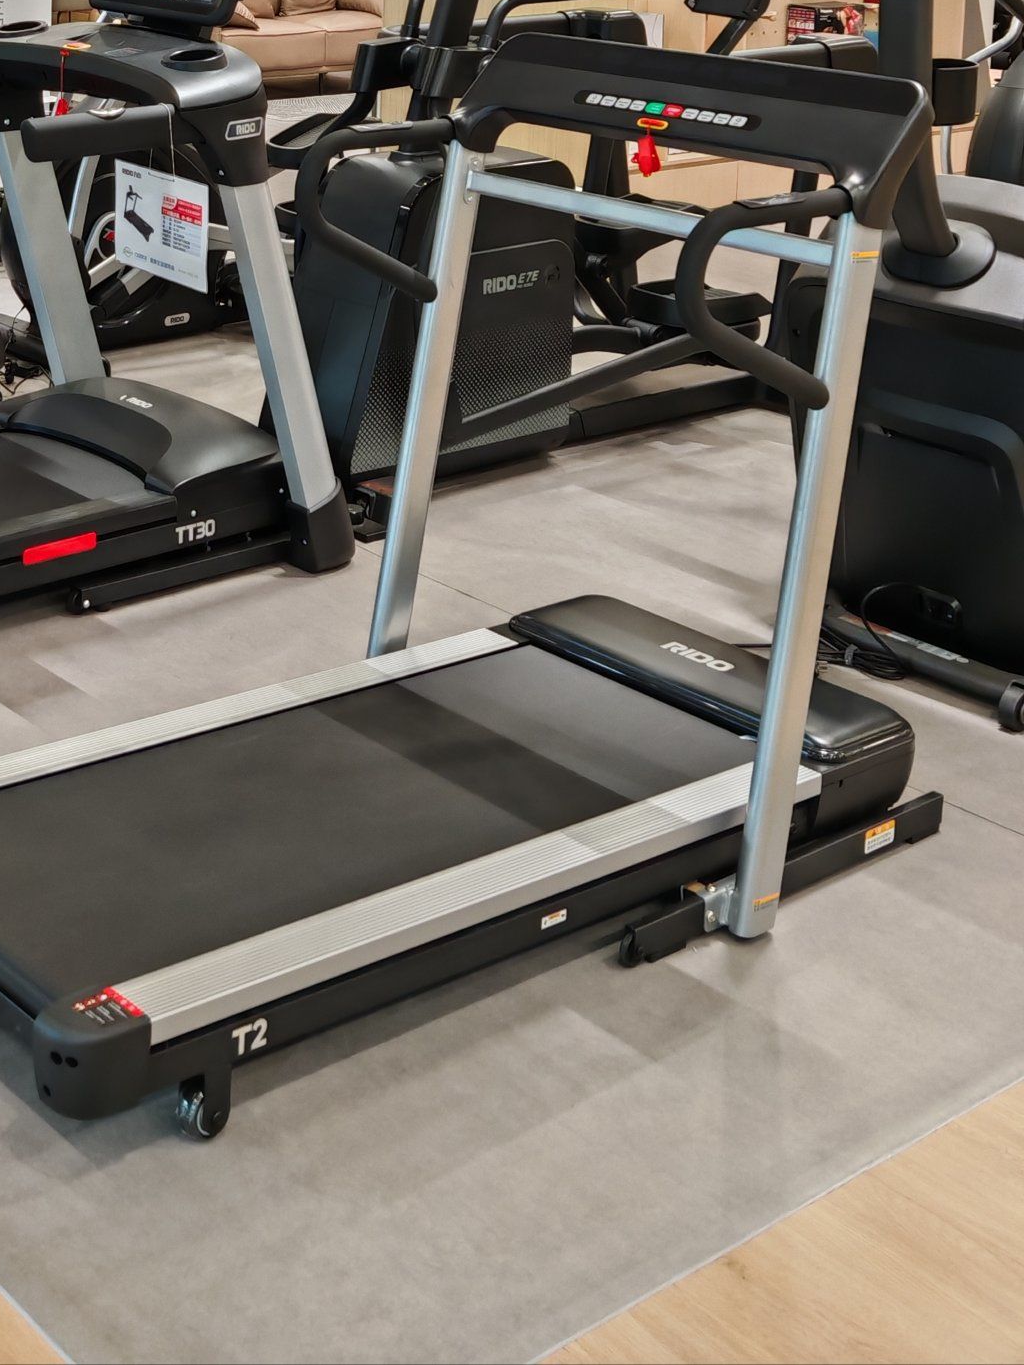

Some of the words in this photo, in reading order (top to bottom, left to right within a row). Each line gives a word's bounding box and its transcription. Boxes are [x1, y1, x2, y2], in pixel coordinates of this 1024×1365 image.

[236, 122, 256, 135] RIDO
[482, 274, 517, 295] RIDO
[517, 270, 540, 284] E7E
[175, 518, 216, 545] TT30
[659, 641, 735, 672] RIDO
[231, 1017, 268, 1056] T2
